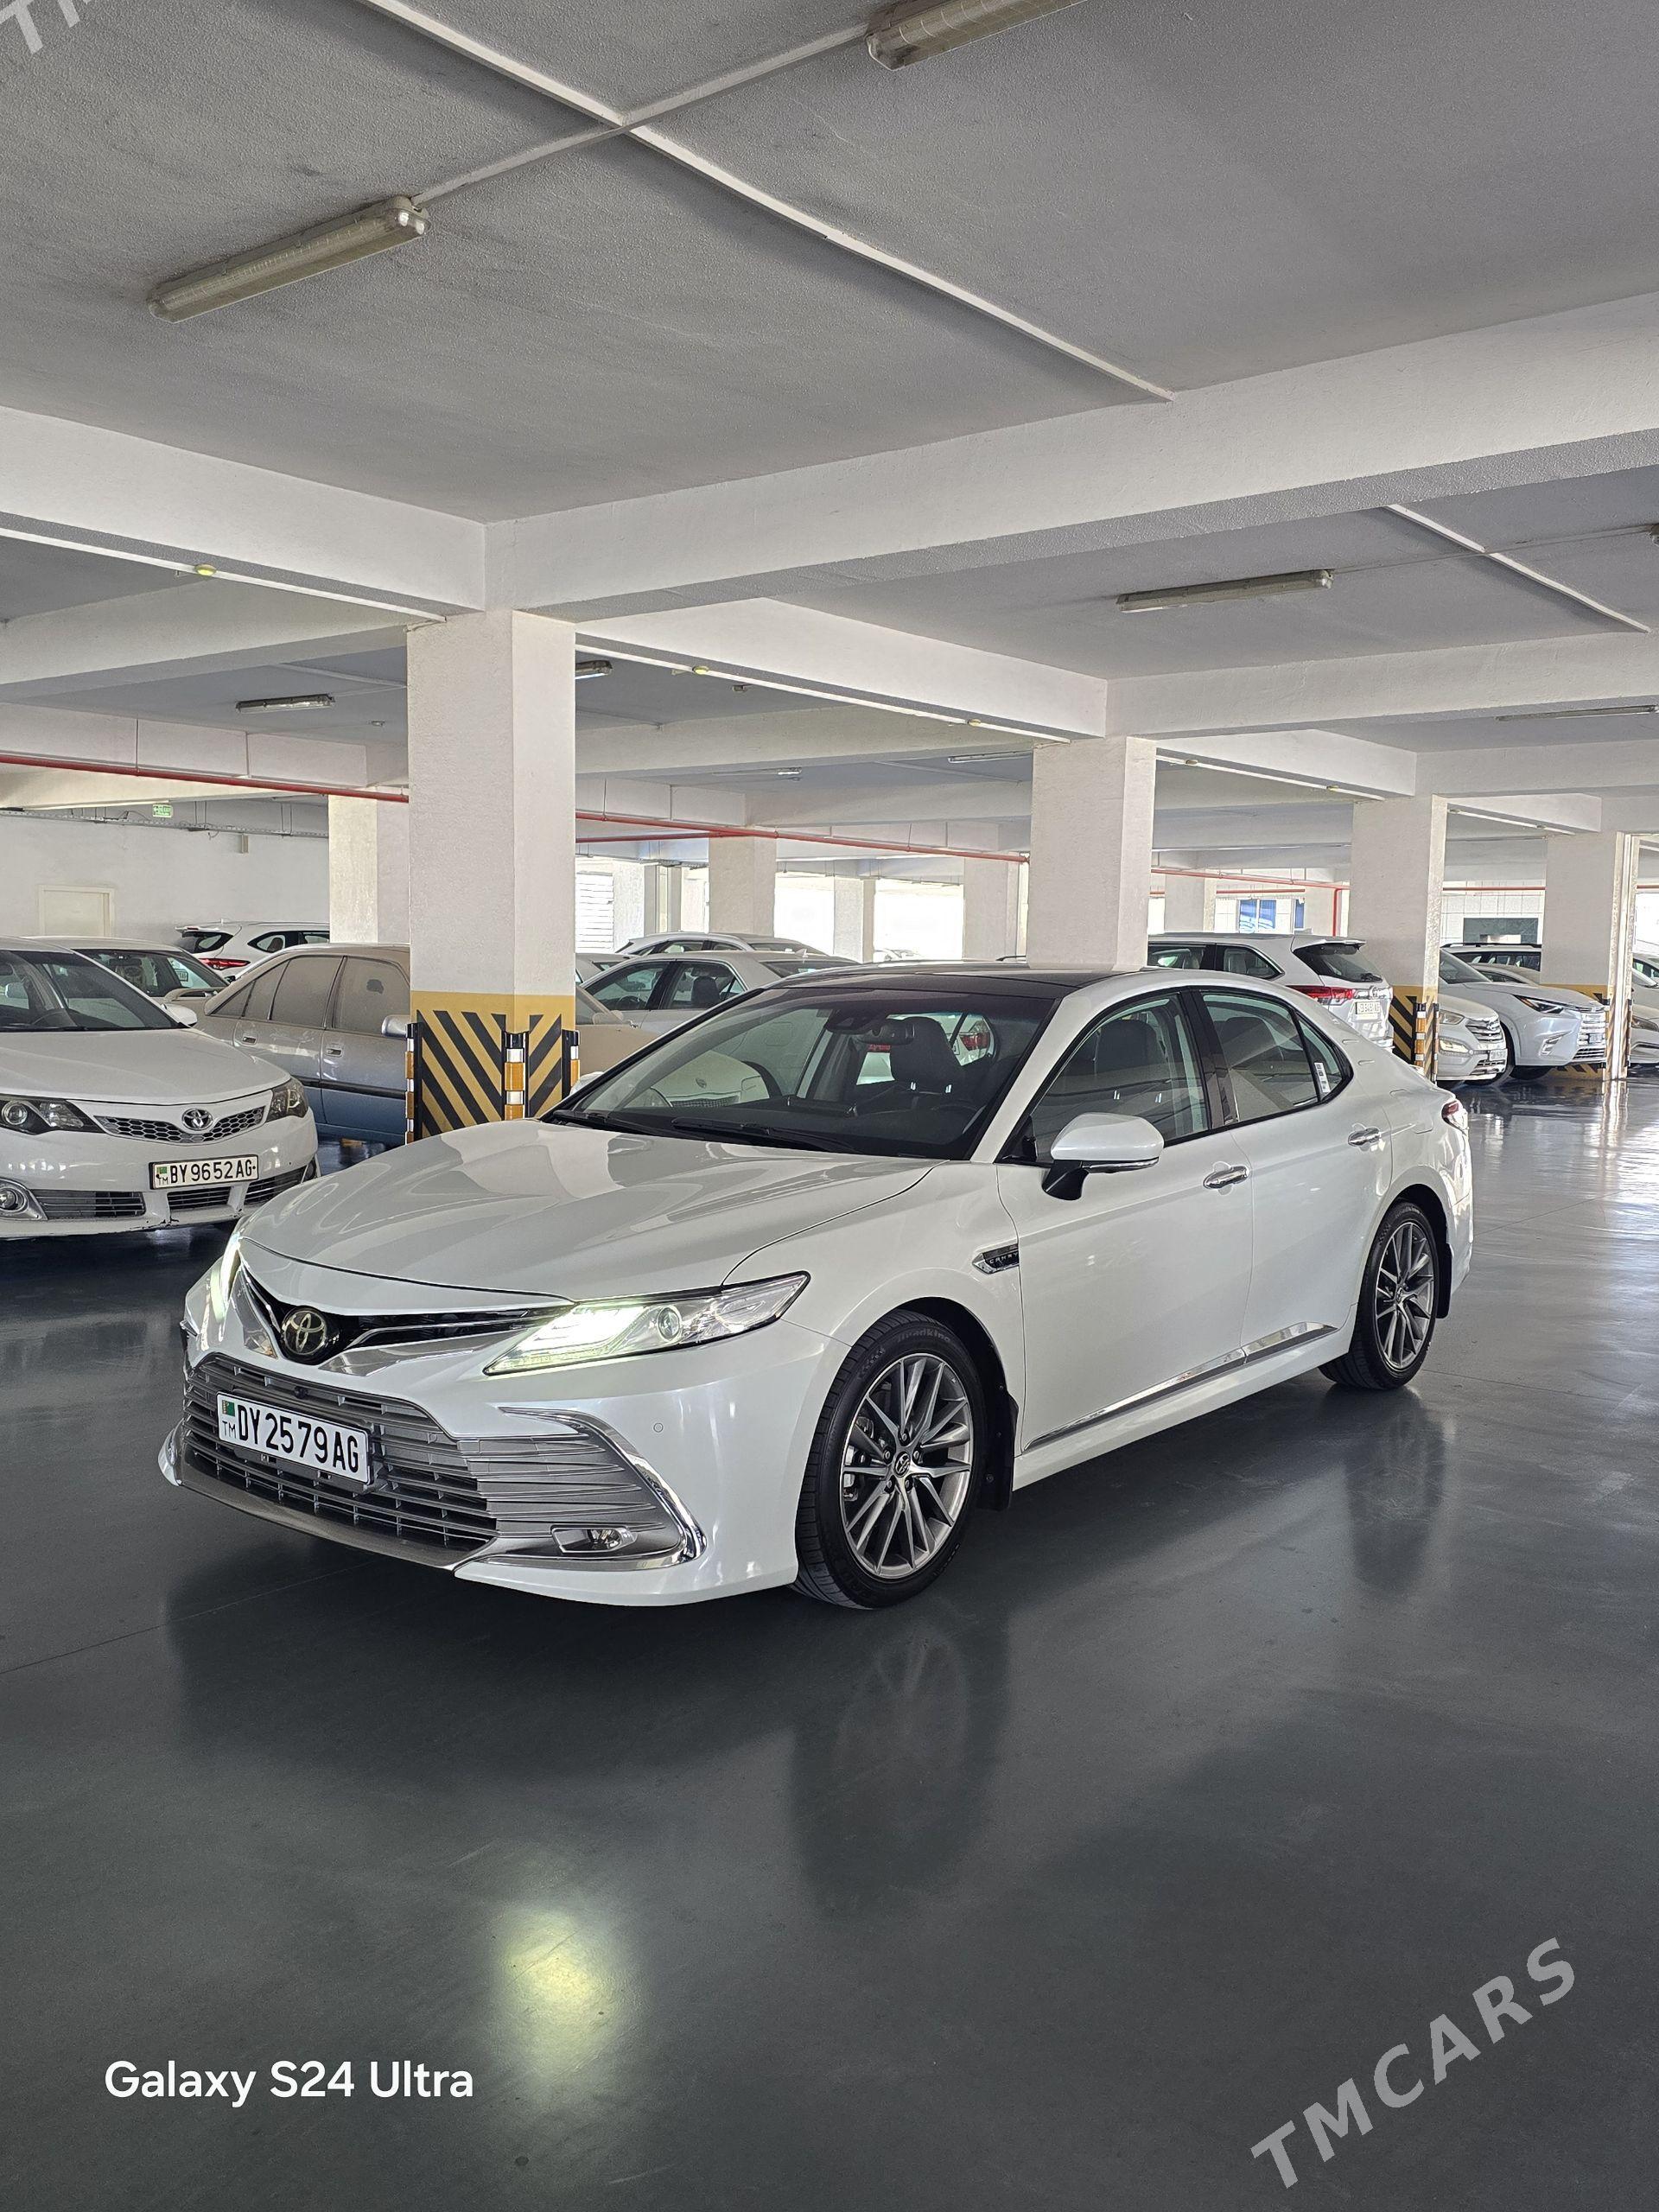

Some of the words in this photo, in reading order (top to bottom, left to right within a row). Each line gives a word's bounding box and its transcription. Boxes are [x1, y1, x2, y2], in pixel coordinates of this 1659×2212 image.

[170, 1159, 252, 1184] BY9652AG
[222, 1420, 237, 1440] TM
[238, 1404, 359, 1473] DY2579AG
